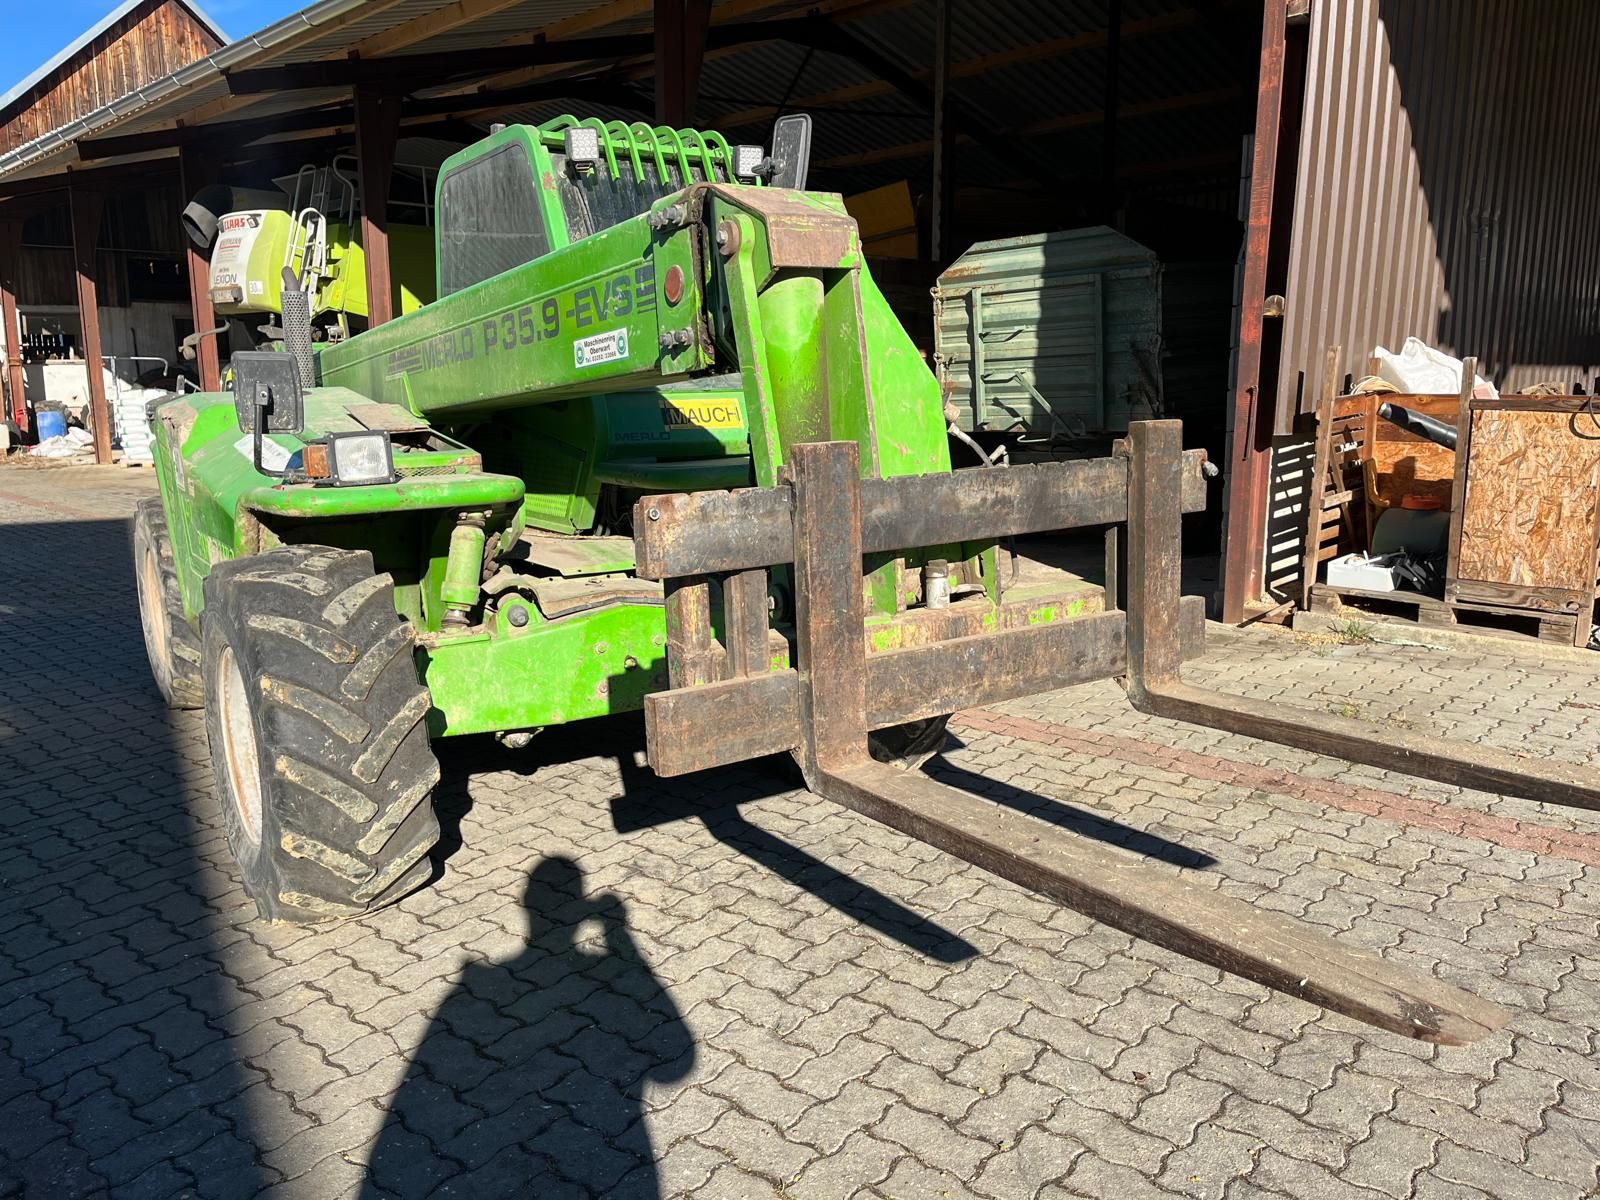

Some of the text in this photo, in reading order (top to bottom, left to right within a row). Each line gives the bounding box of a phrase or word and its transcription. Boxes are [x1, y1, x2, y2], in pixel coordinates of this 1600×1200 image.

[223, 218, 246, 229] CLAAS
[584, 335, 616, 348] Maschinenring
[422, 329, 474, 371] MERLO
[589, 344, 611, 355] Oberwart
[669, 407, 741, 424] MAUCH
[614, 431, 671, 441] MERLO
